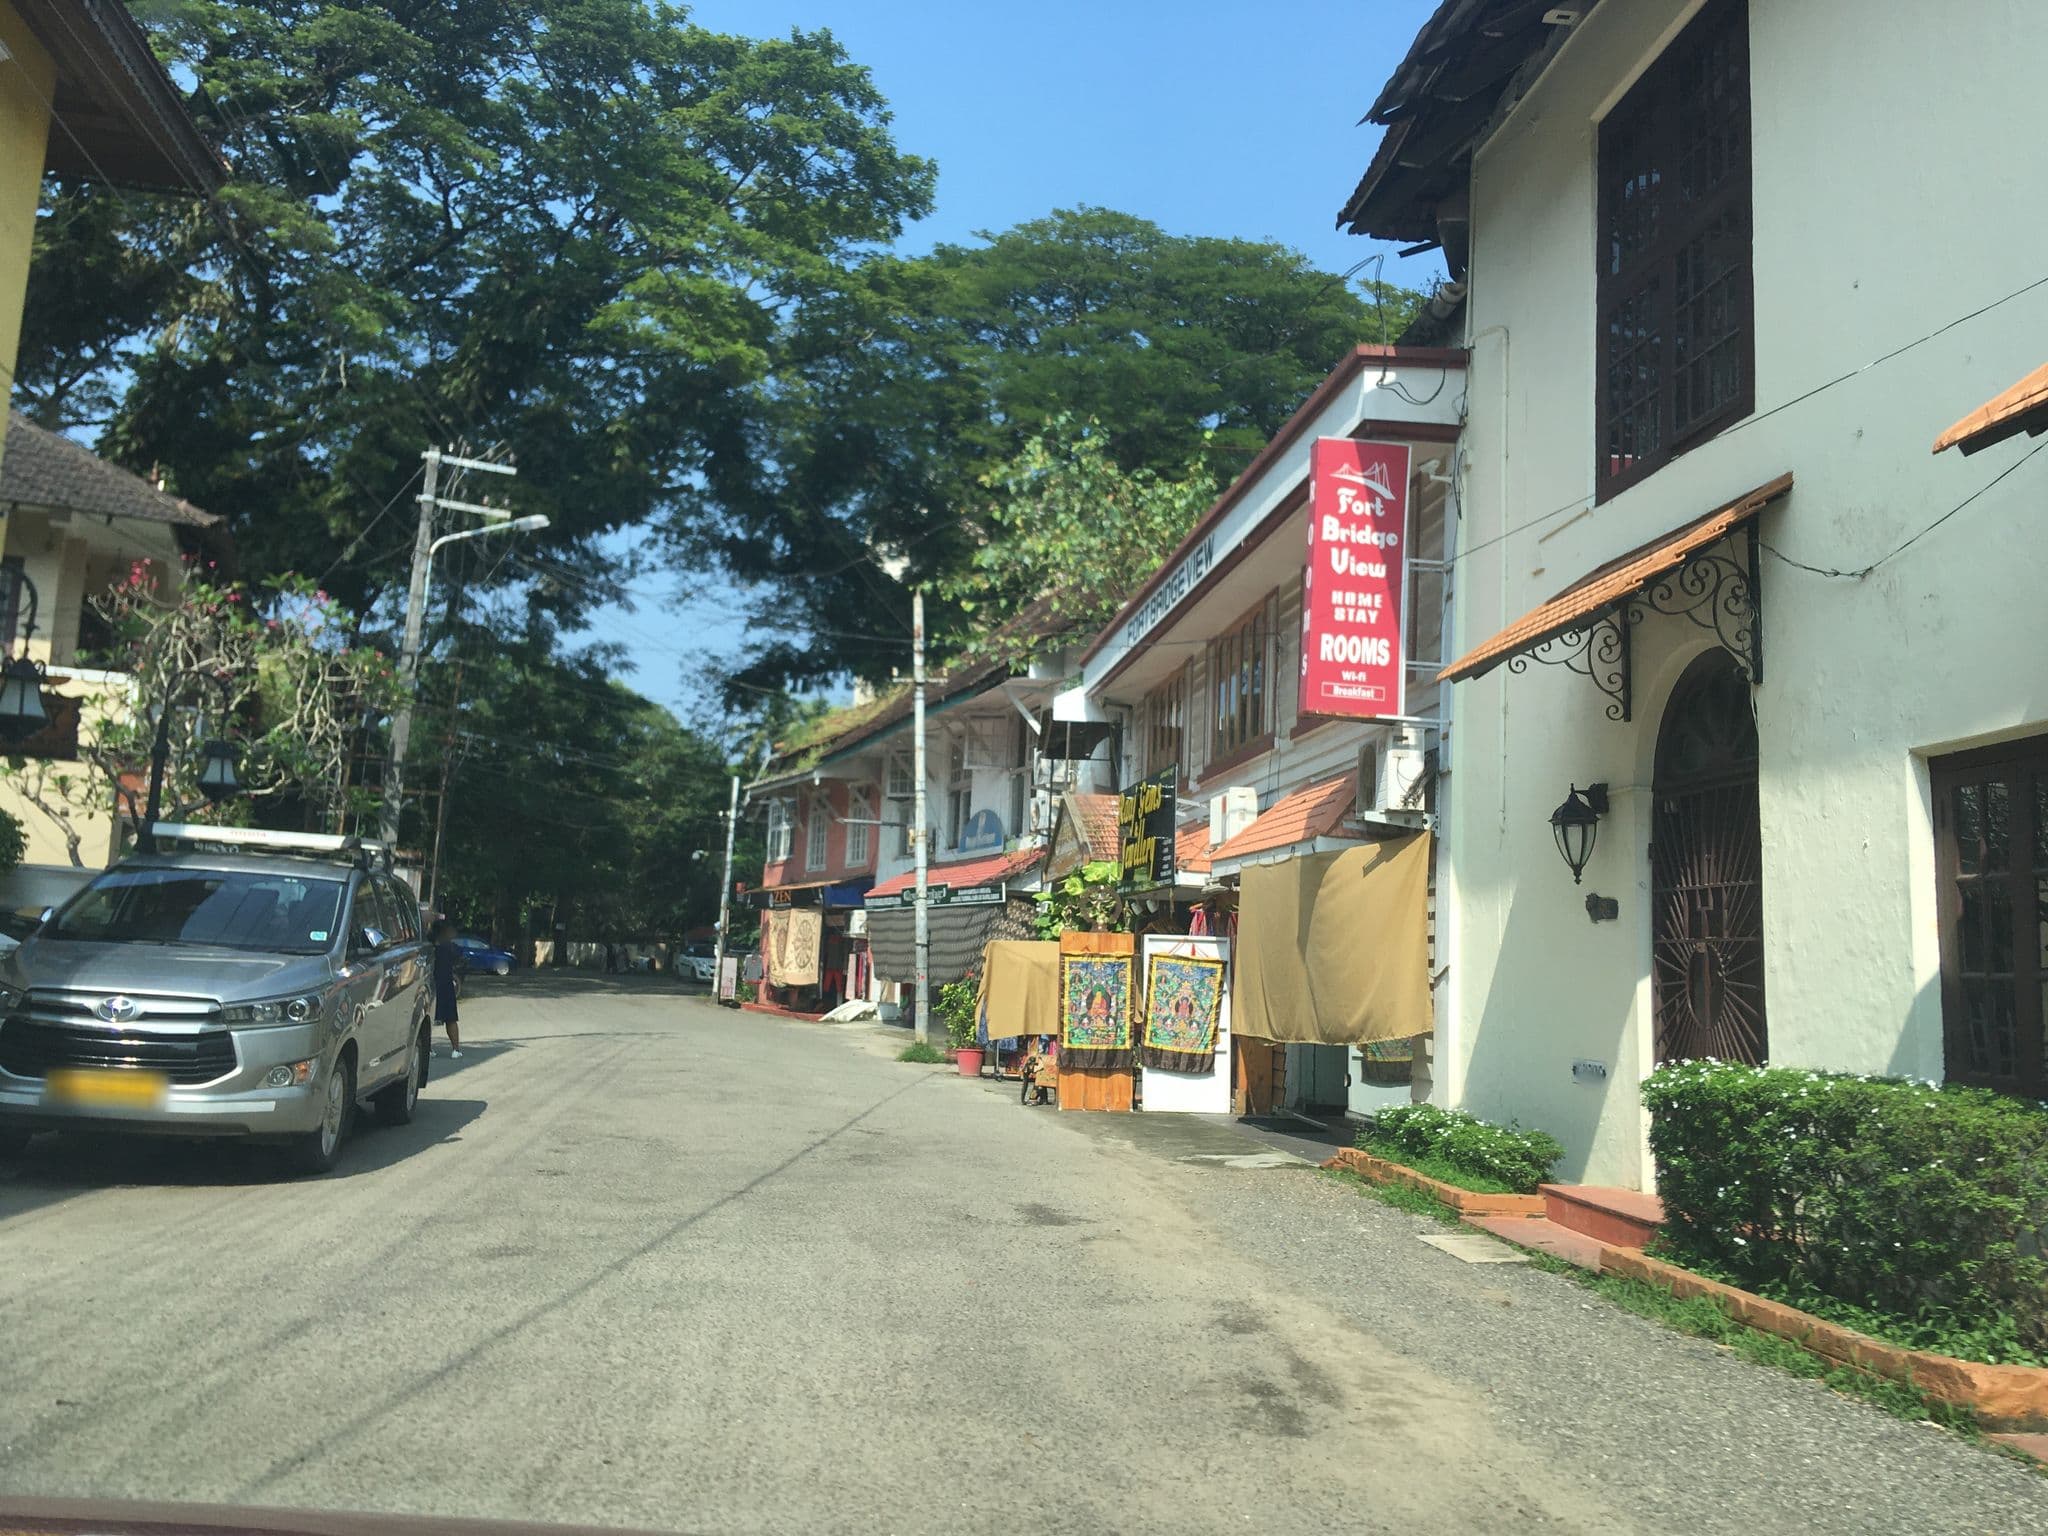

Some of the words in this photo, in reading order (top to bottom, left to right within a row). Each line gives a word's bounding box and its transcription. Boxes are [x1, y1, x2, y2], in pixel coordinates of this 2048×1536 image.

[1337, 487, 1385, 517] Fort
[1321, 515, 1398, 549] Bridge
[1330, 547, 1387, 578] View
[1127, 604, 1151, 644] FORT
[1151, 566, 1185, 624] BRIDGE
[1185, 533, 1215, 588] VIEW
[1331, 591, 1382, 608] HOME
[1334, 608, 1379, 624] STAY
[1320, 633, 1391, 666] ROOMS
[1333, 684, 1375, 699] Breakfast
[774, 889, 791, 903] ZEN
